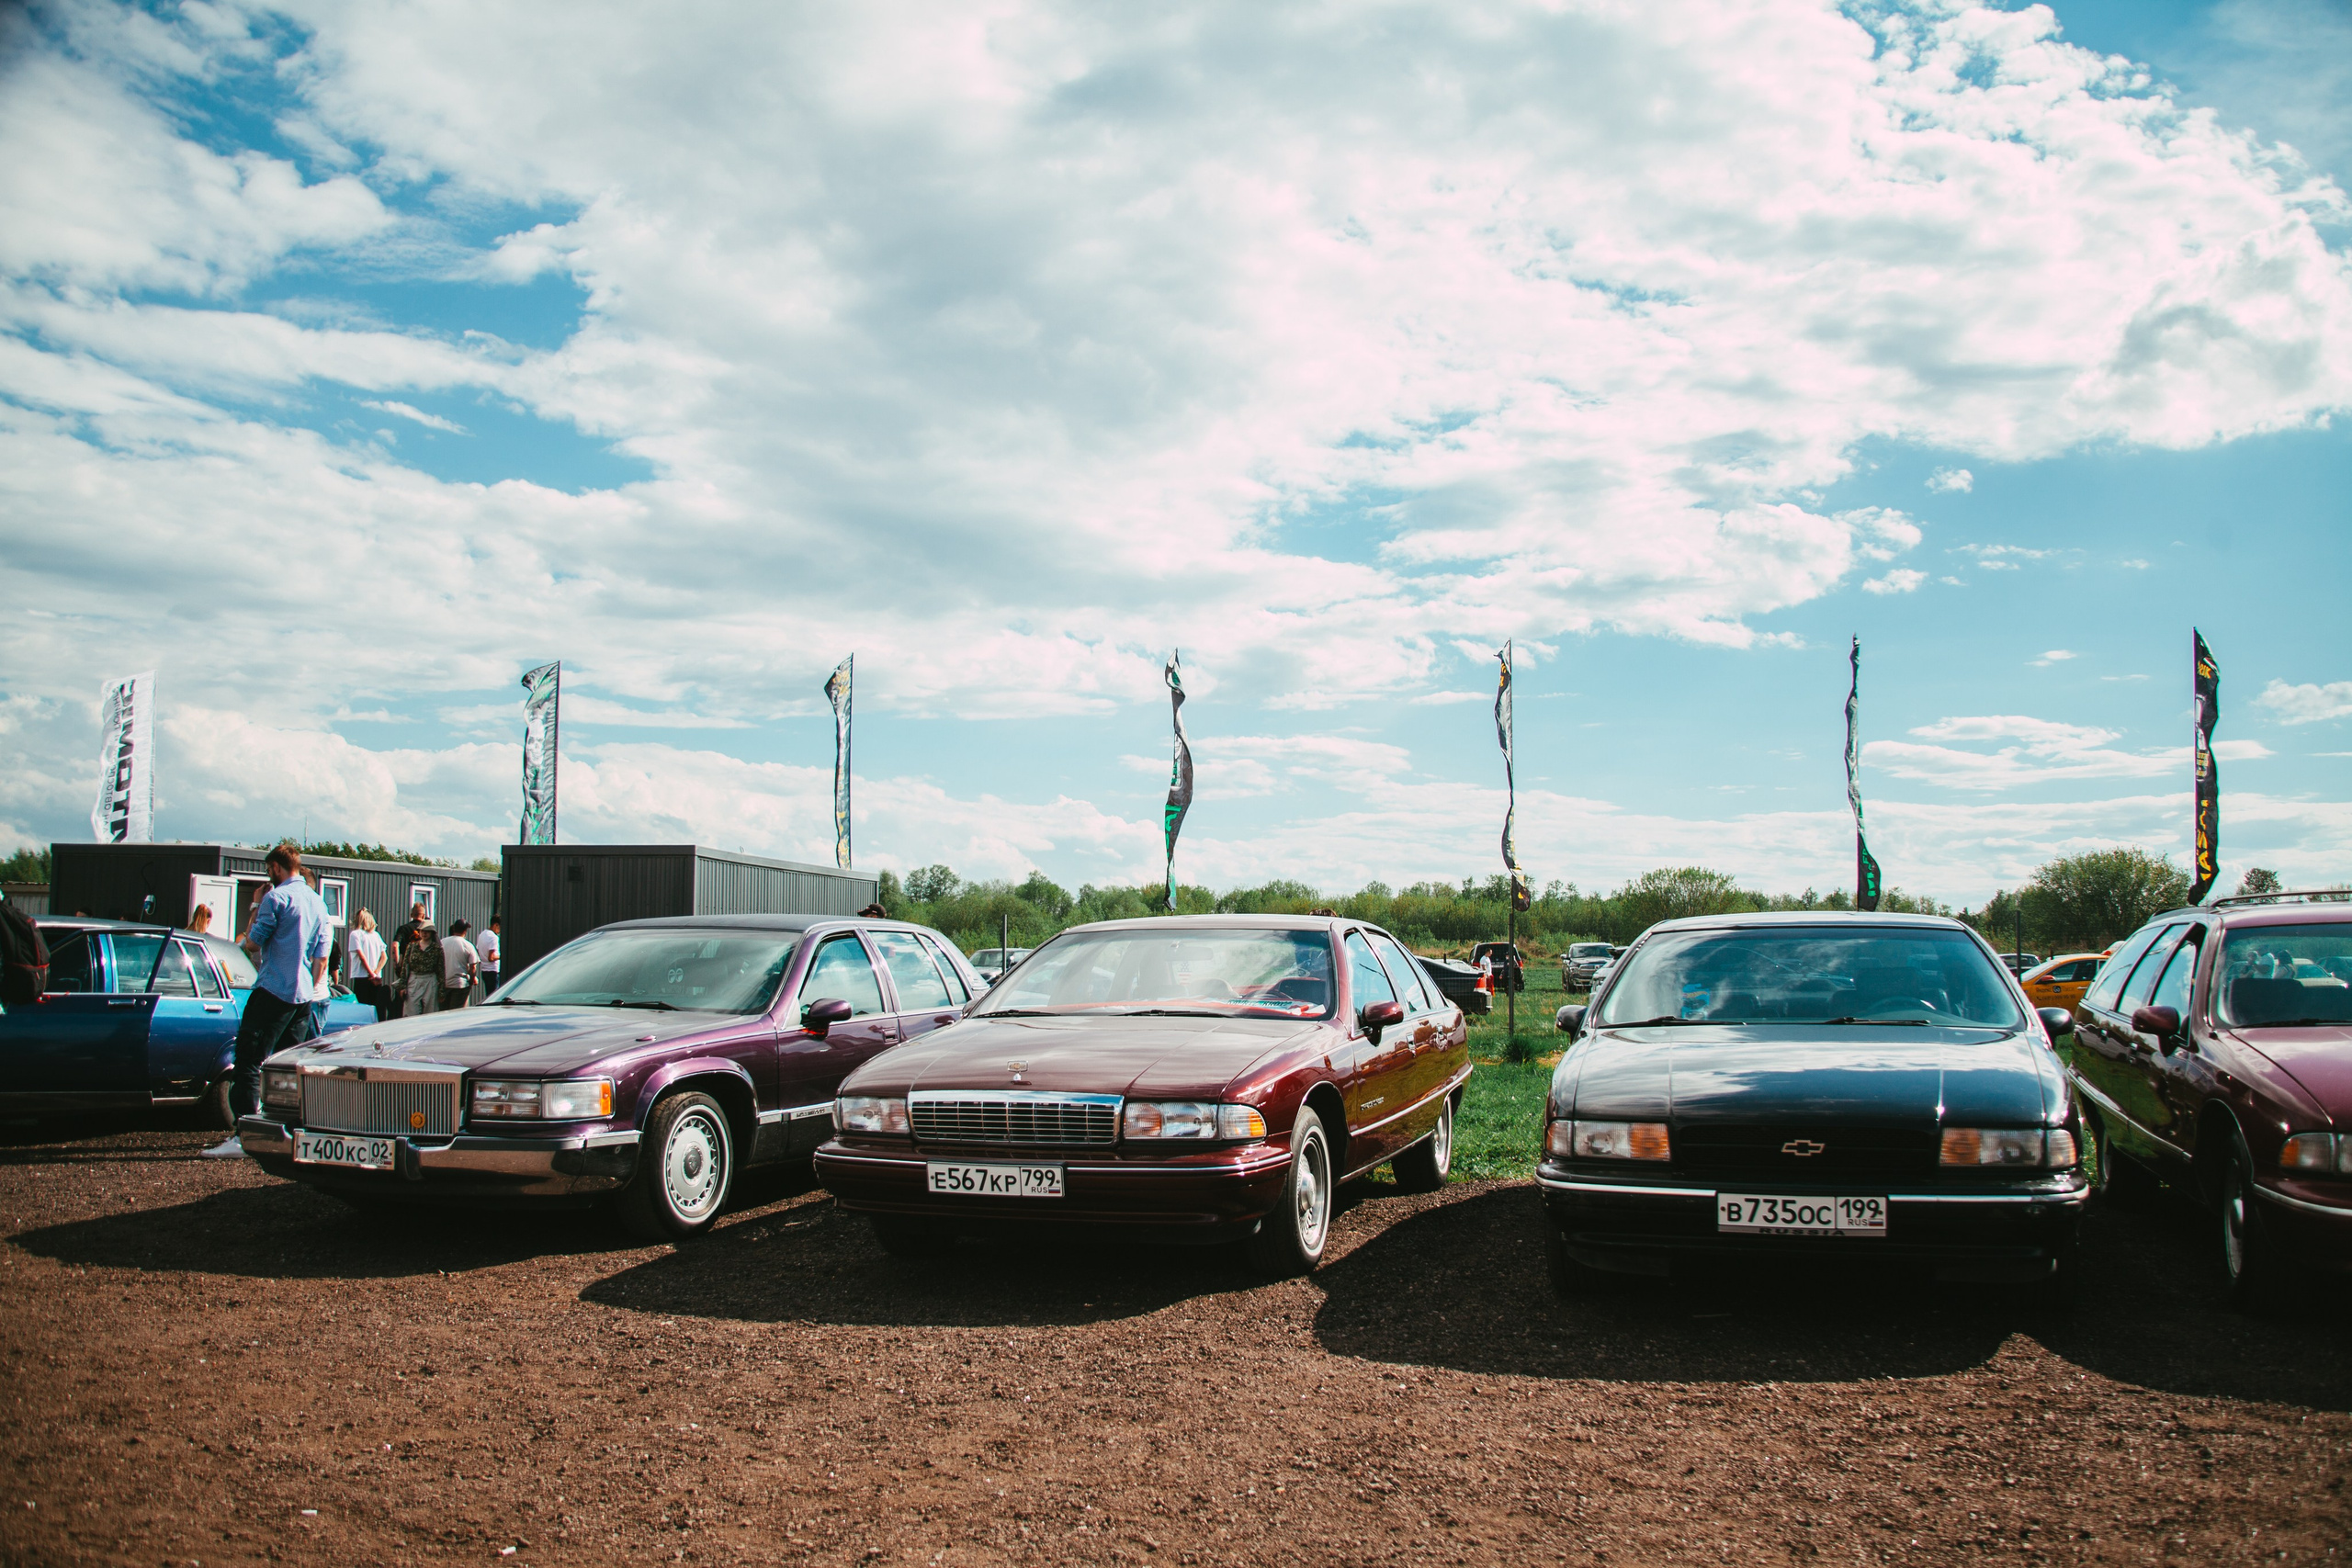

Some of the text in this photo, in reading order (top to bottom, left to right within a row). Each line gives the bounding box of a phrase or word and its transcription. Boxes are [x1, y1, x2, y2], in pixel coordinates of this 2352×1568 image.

[371, 1142, 389, 1159] 02
[1022, 1169, 1056, 1187] 799
[1838, 1199, 1880, 1218] 199
[1847, 1218, 1868, 1226] RUS
[1758, 1227, 1846, 1236] RUSSIA
